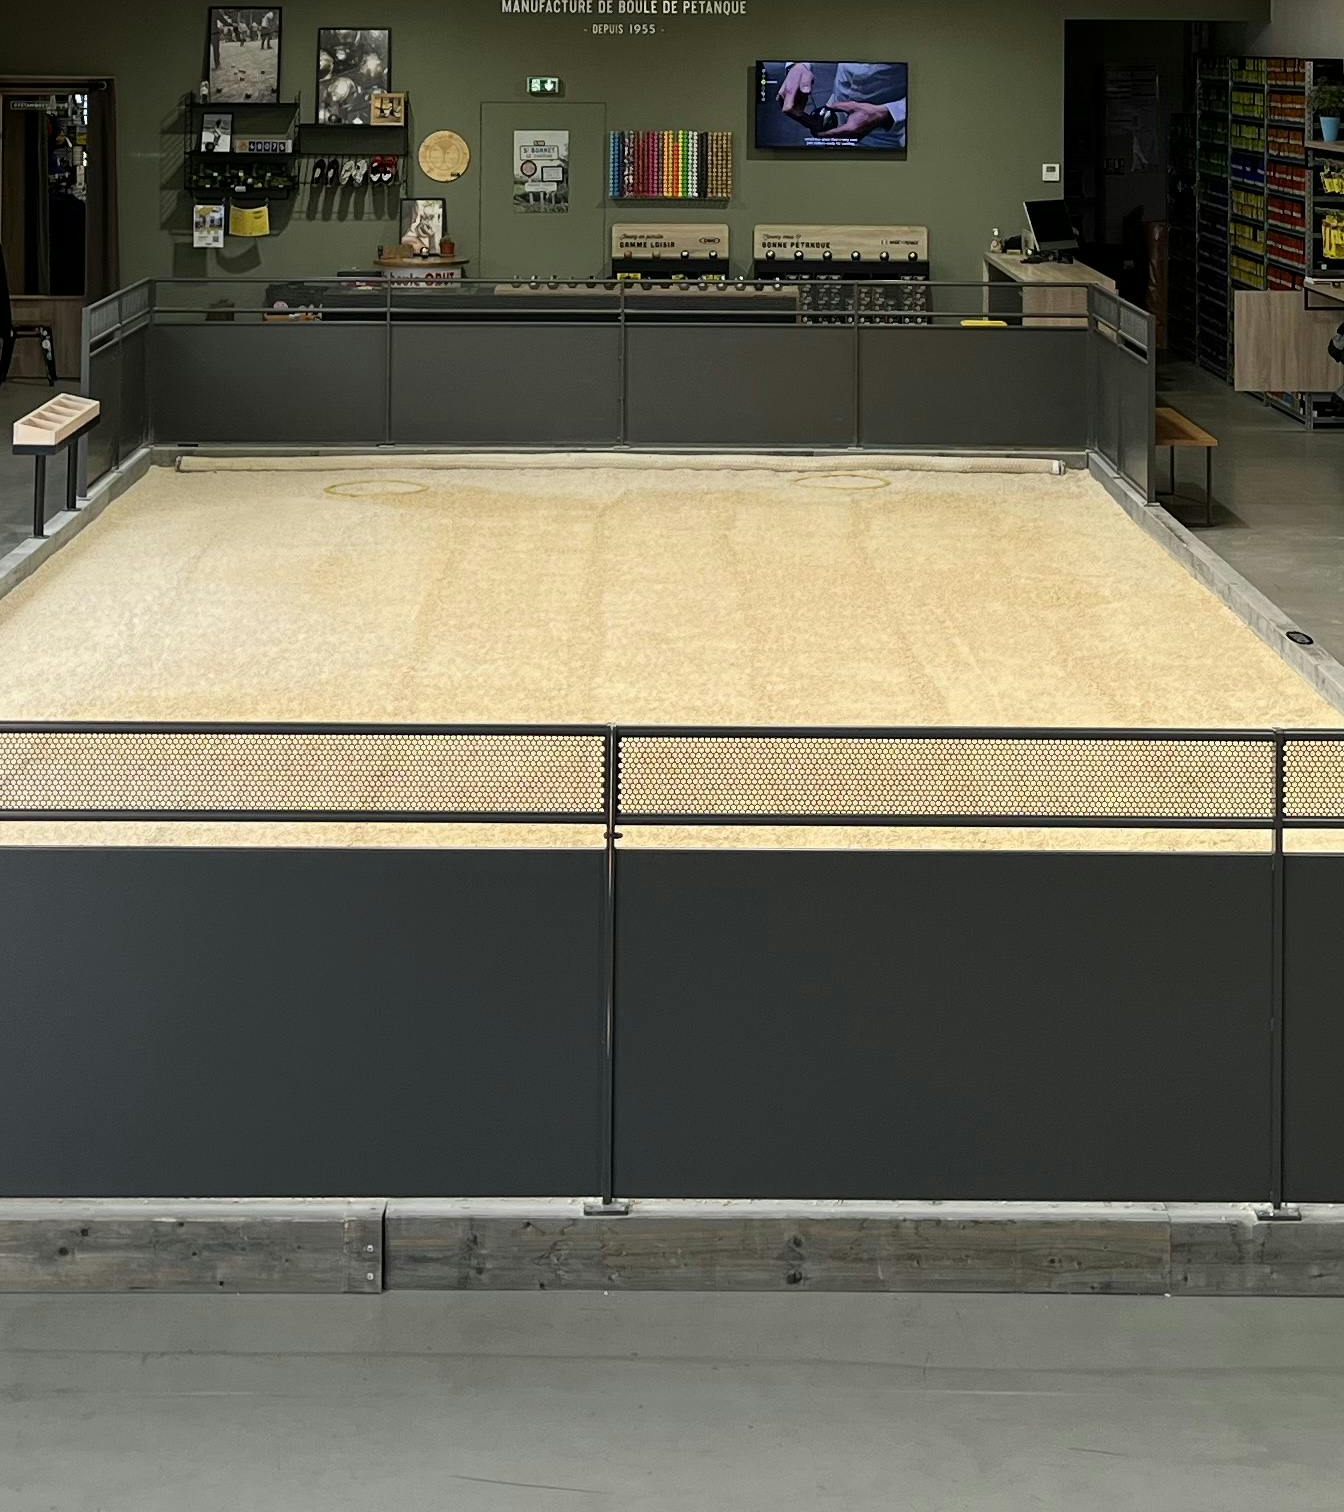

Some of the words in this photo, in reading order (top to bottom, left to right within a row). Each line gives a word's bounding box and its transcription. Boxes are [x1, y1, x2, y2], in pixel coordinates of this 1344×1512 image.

[501, 0, 593, 14] MANUFACTURE
[598, 0, 613, 14] DE
[618, 0, 657, 14] BOULE
[663, 0, 678, 14] DE
[683, 0, 747, 15] PETANQUE
[592, 24, 623, 34] DEPUIS
[629, 23, 656, 34] 1955
